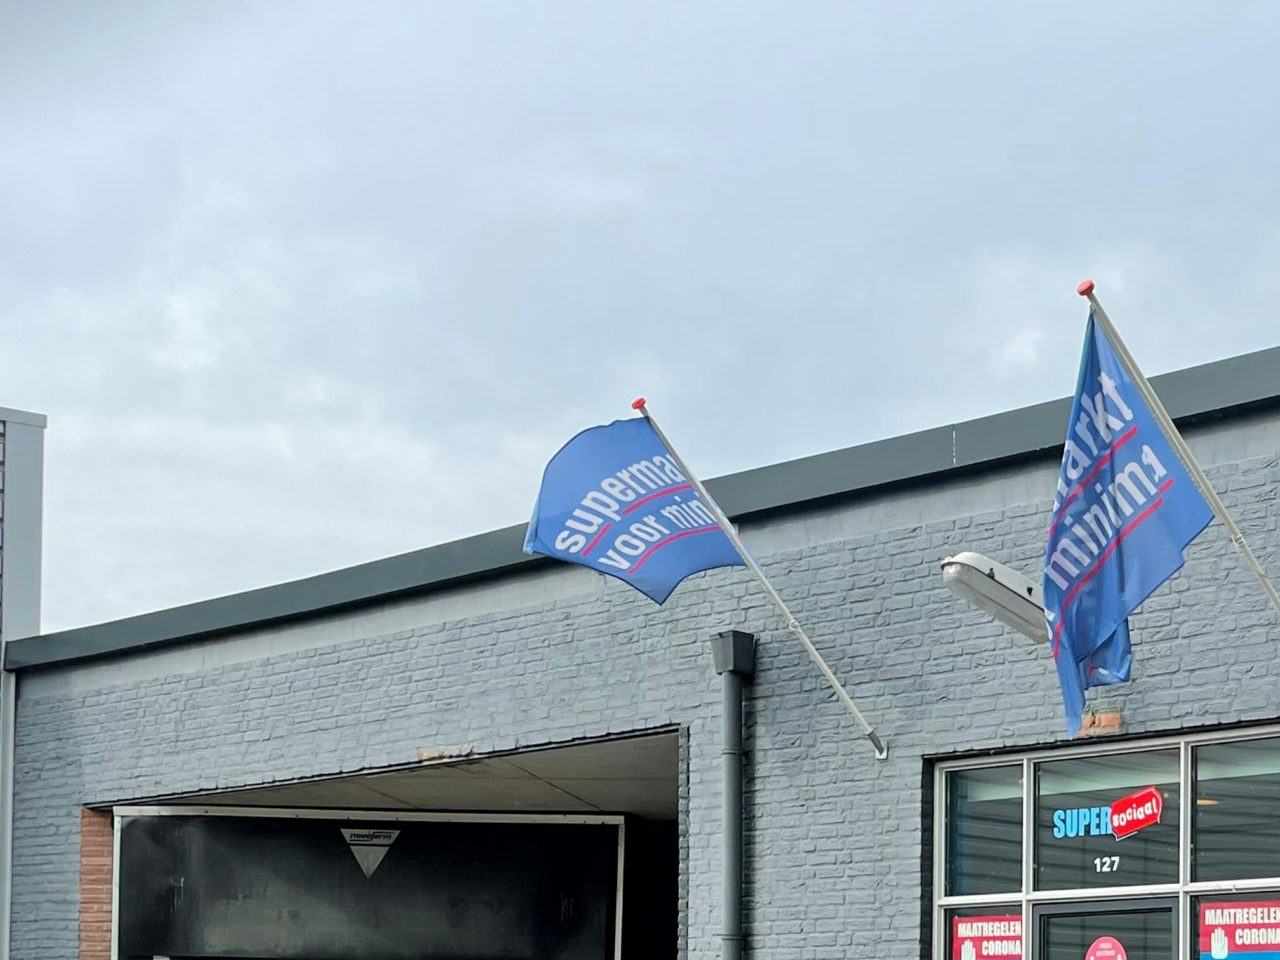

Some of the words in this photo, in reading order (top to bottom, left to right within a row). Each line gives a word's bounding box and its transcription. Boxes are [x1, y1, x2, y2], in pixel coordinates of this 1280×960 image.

[598, 514, 671, 570] voor
[1053, 806, 1112, 838] SUPER
[1112, 798, 1158, 827] sociaal
[1094, 856, 1119, 872] 127
[957, 920, 1022, 938] MAATREGELEN
[981, 939, 1022, 956] CORONA
